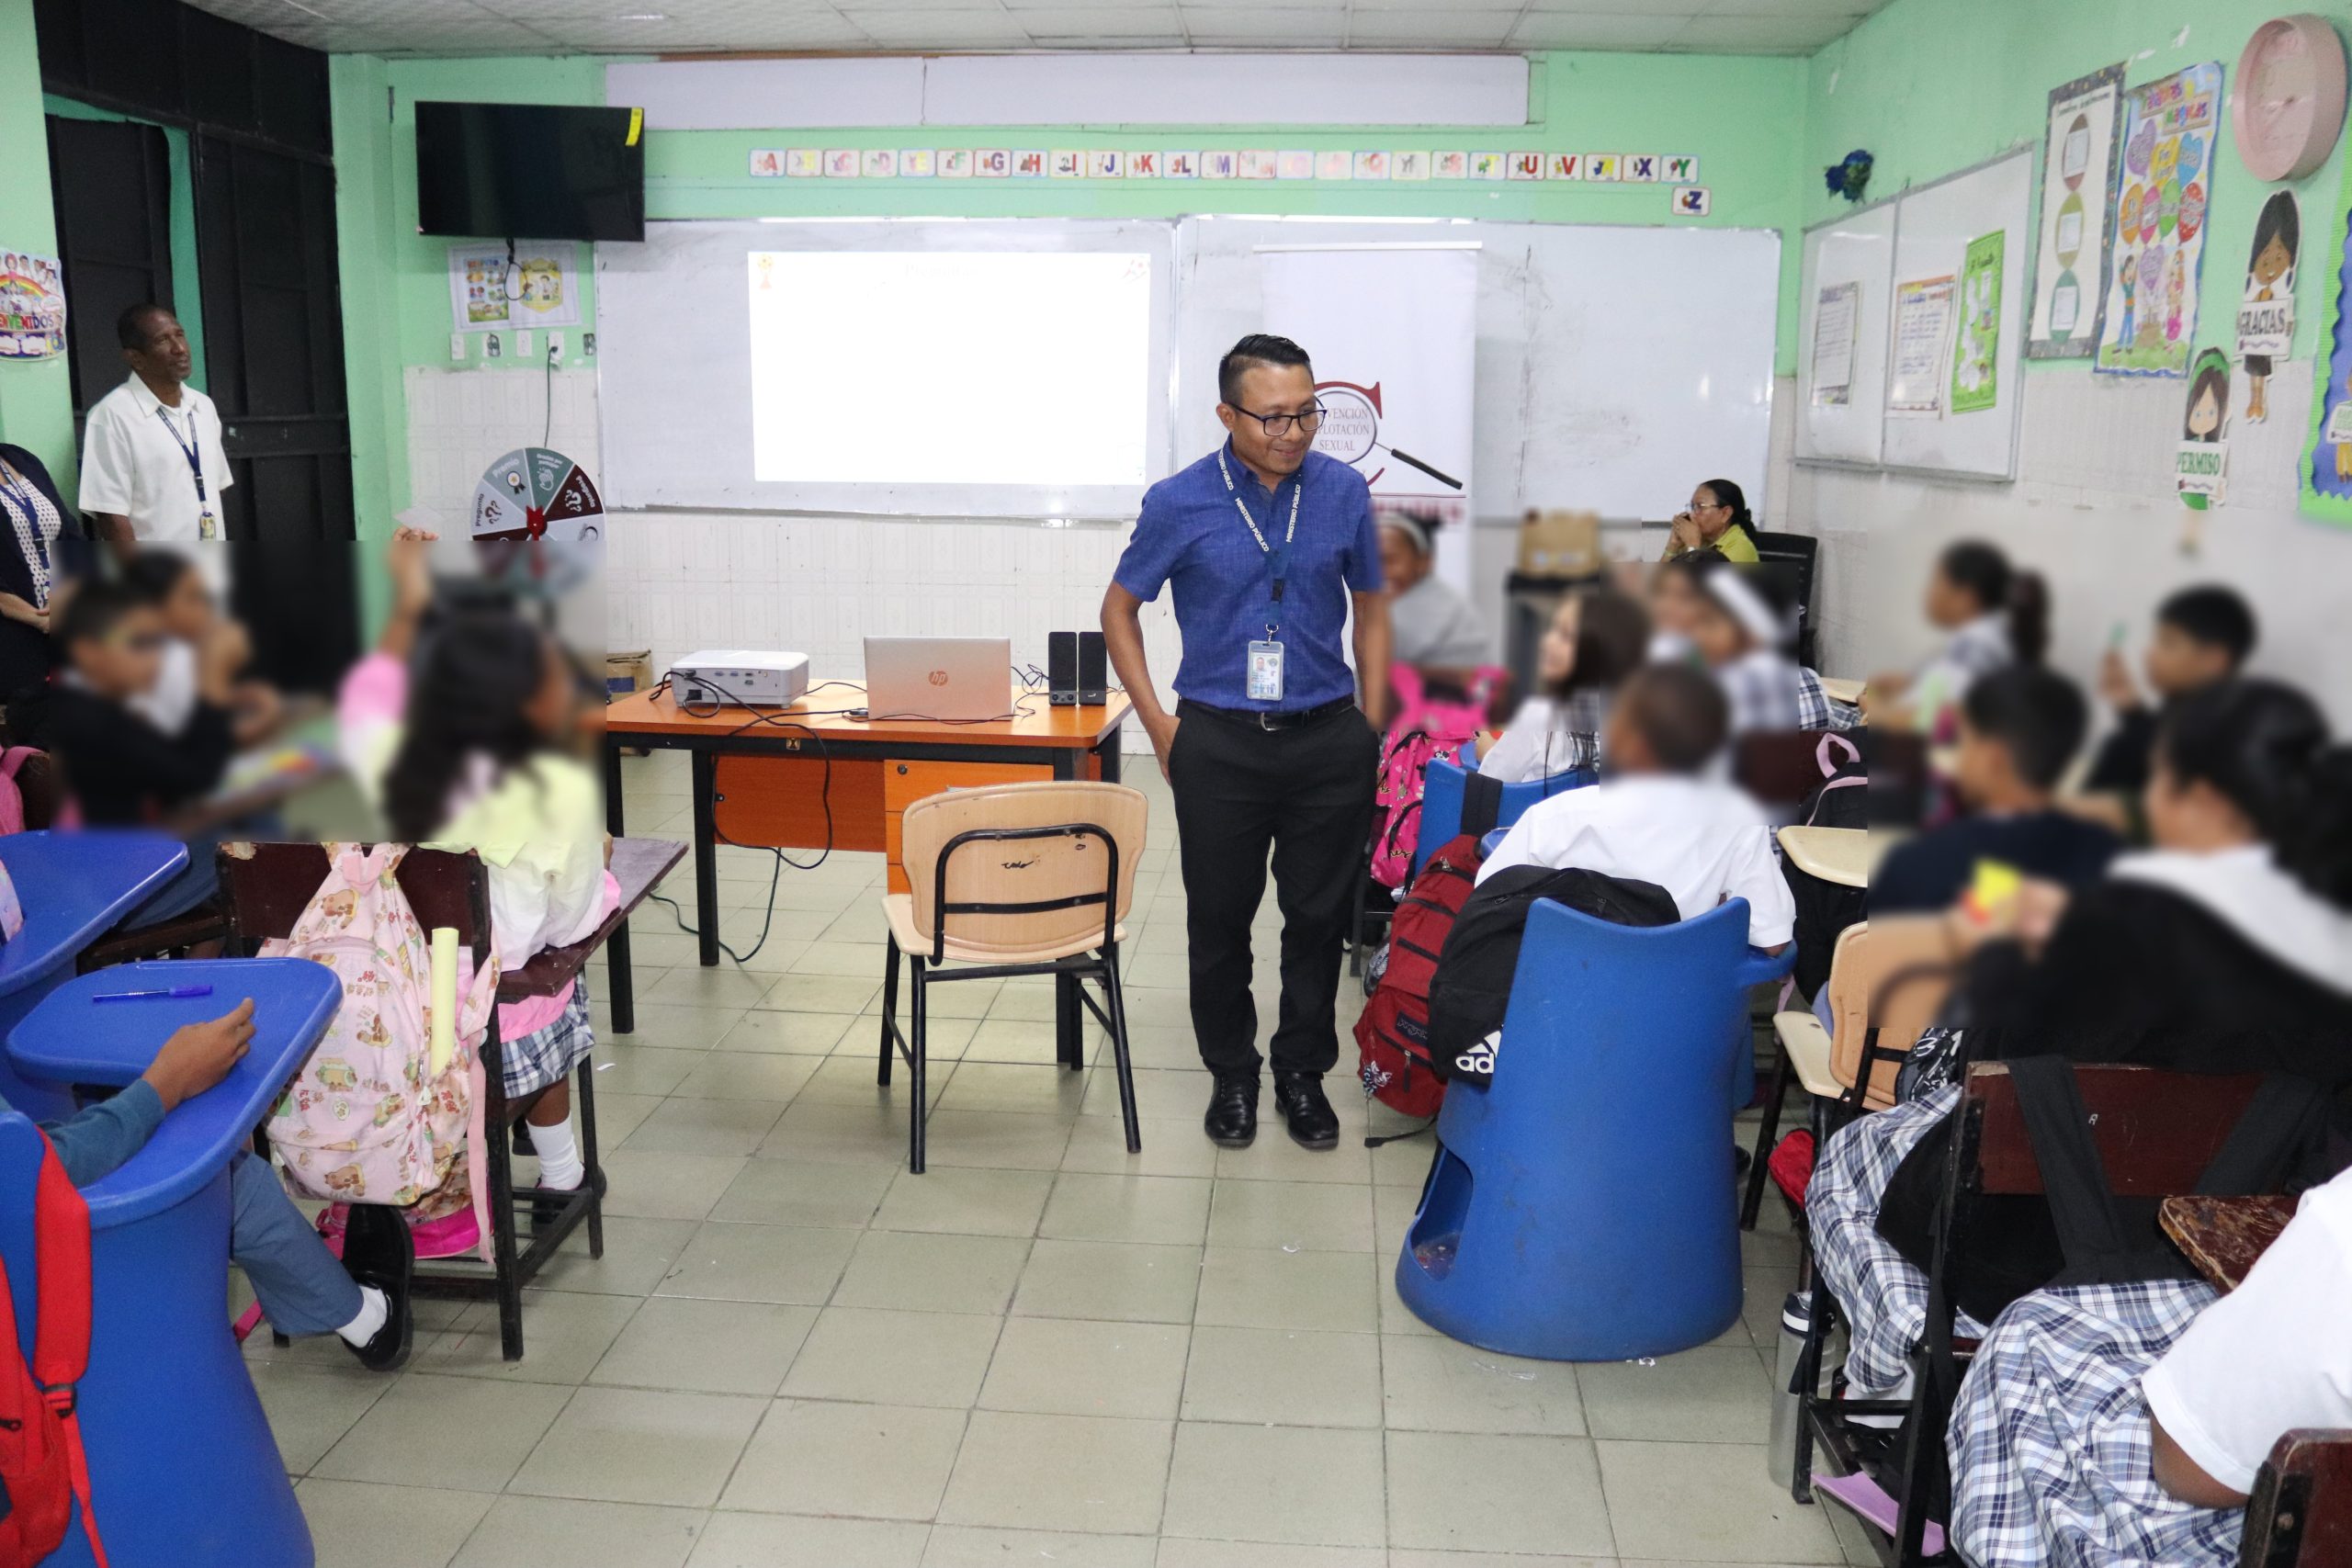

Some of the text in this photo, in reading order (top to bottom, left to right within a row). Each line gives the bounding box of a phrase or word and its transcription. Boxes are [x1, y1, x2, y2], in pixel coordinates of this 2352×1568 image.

[766, 152, 778, 171] A
[990, 152, 1004, 171] G
[1028, 153, 1041, 173] H
[1071, 153, 1077, 172] I
[1104, 153, 1115, 173] J
[1141, 154, 1154, 173] K
[1181, 154, 1192, 174] L
[1216, 155, 1230, 174] M
[1485, 155, 1499, 175] T
[1525, 155, 1538, 175] U
[1561, 156, 1577, 175] V
[1637, 158, 1652, 176] X
[1677, 158, 1690, 177] Y
[1688, 190, 1702, 209] Z
[2239, 308, 2286, 336] GRACIAS
[1319, 440, 1355, 451] SEXUAL
[2177, 451, 2221, 477] PERMISO
[1235, 497, 1254, 528] MINISTERIO
[1286, 509, 1298, 543] MINISTERIO
[930, 670, 947, 686] hp
